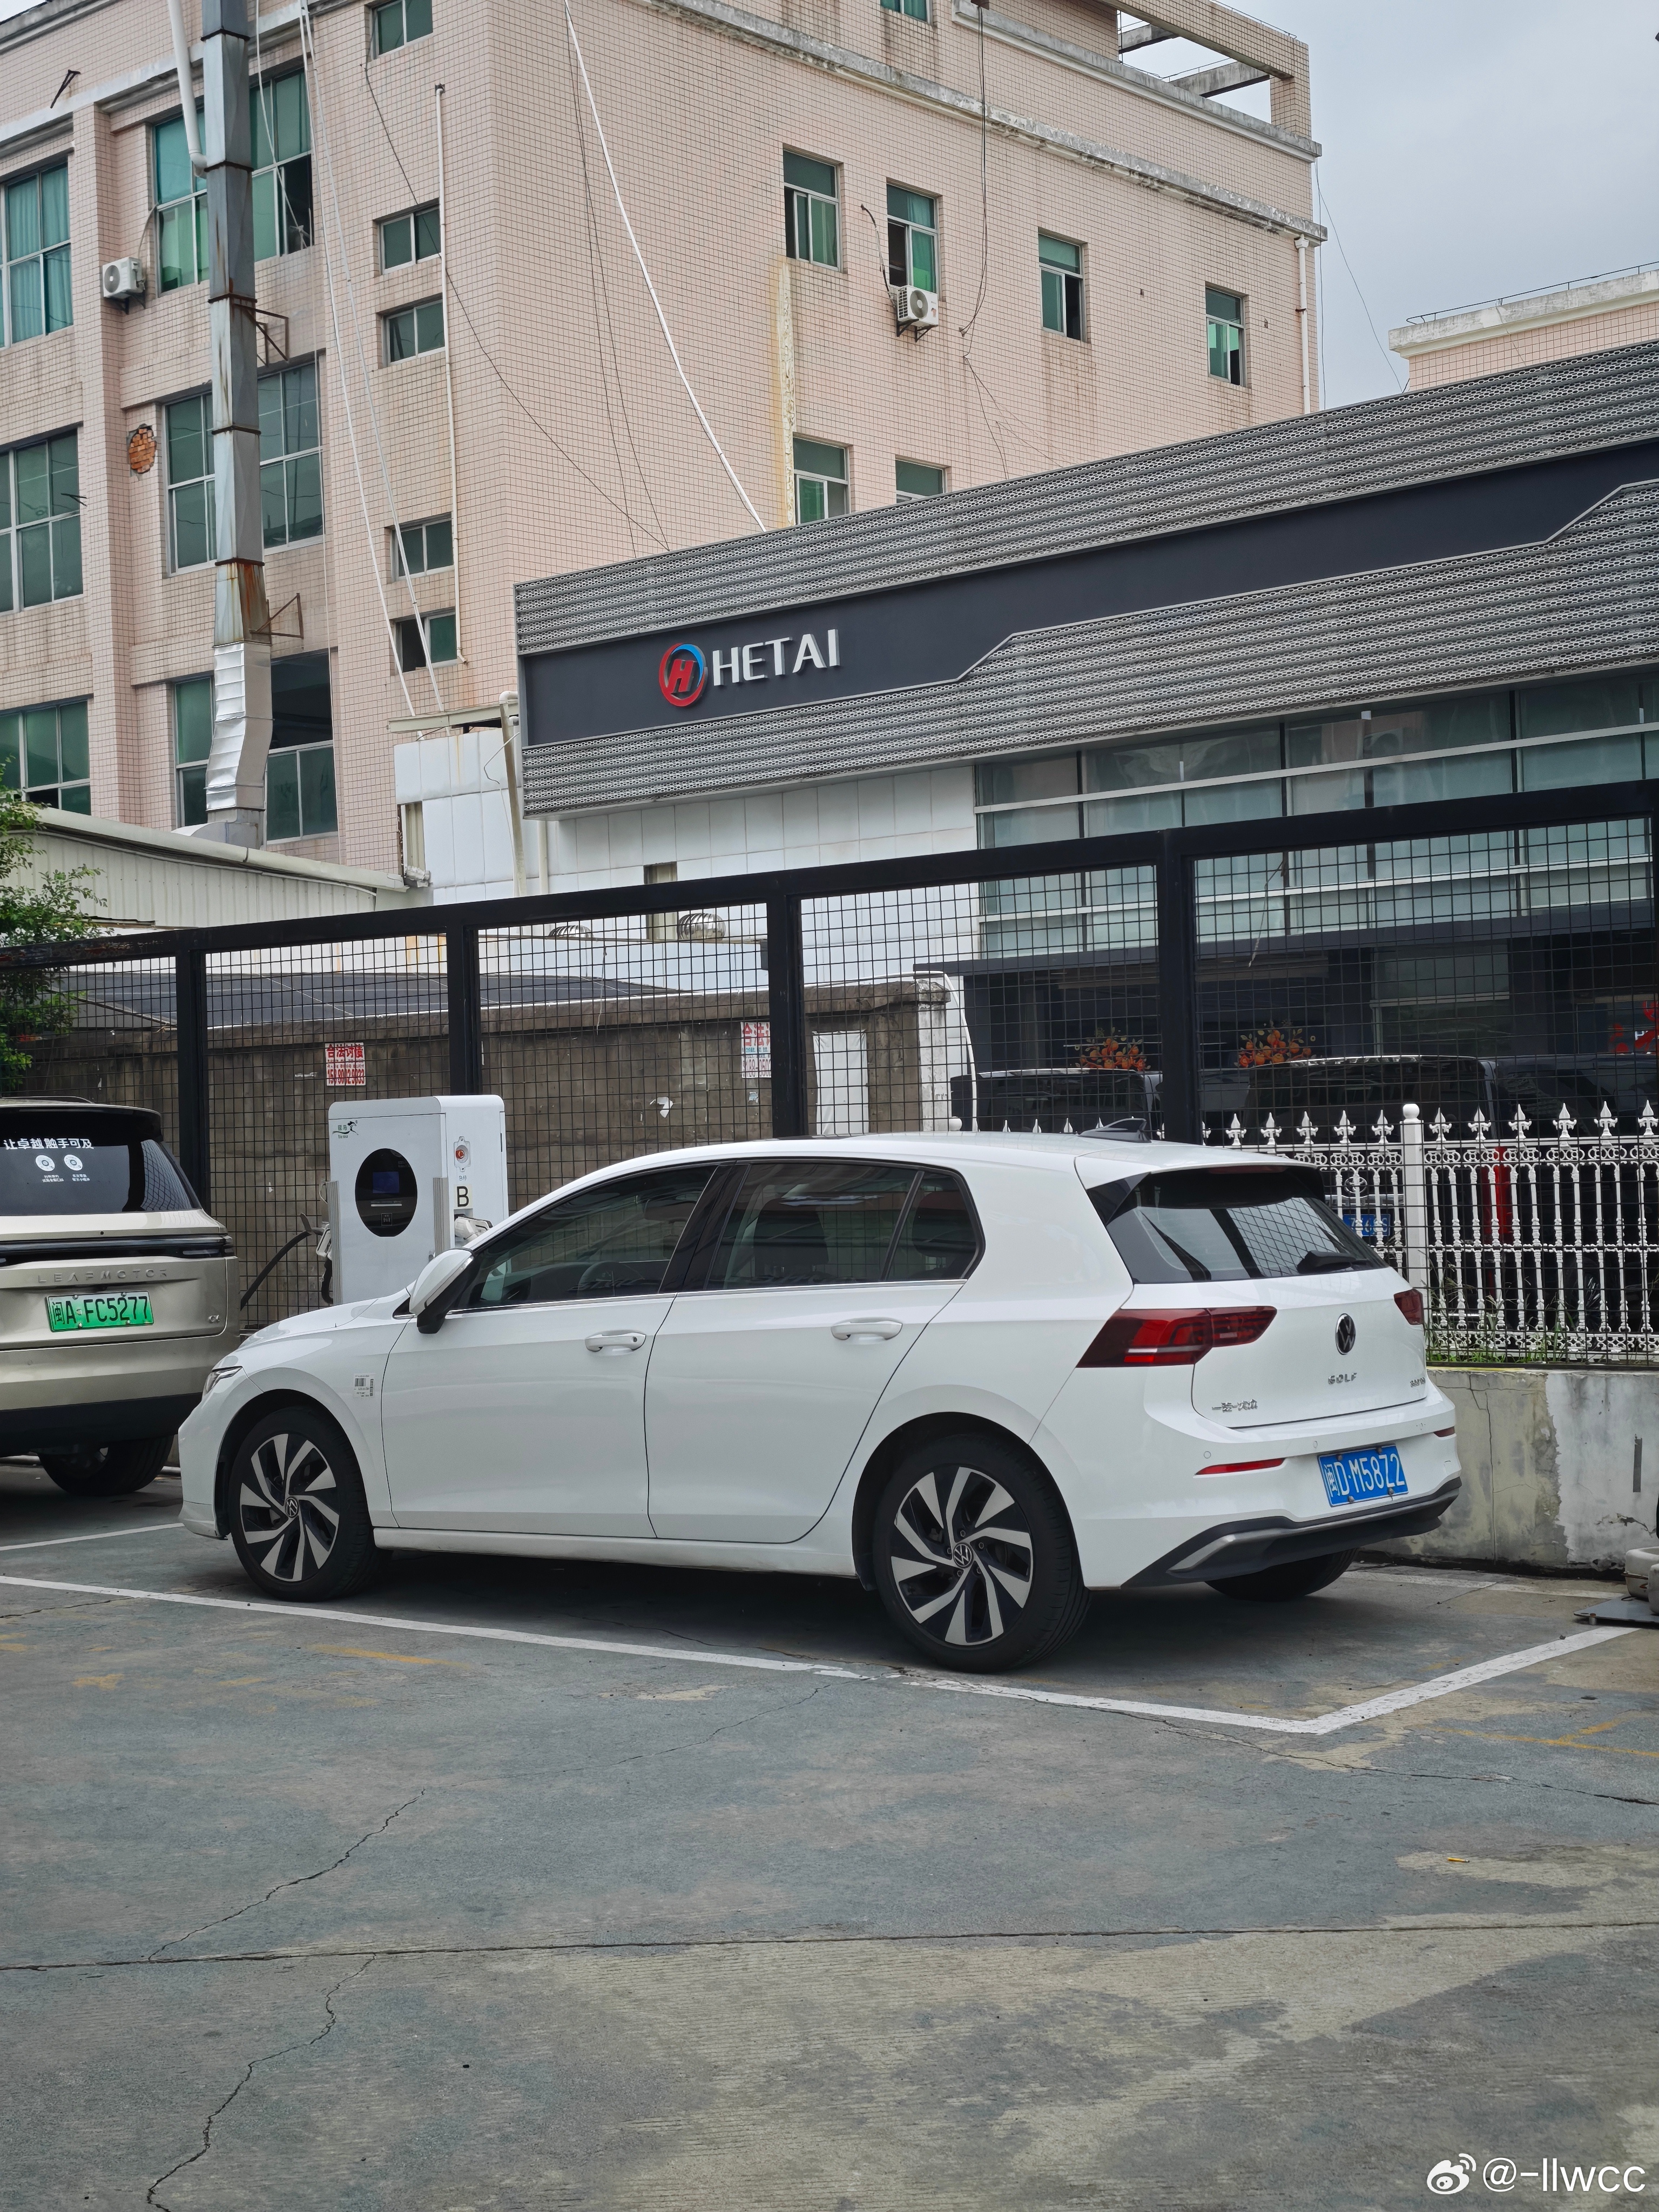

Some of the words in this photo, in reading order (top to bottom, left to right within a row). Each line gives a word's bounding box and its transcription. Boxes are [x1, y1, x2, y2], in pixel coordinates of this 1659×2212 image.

[712, 629, 840, 686] HETAI
[3, 1138, 95, 1150] 让卓越触手可及
[456, 1186, 469, 1207] B
[1328, 1372, 1357, 1385] GOLF
